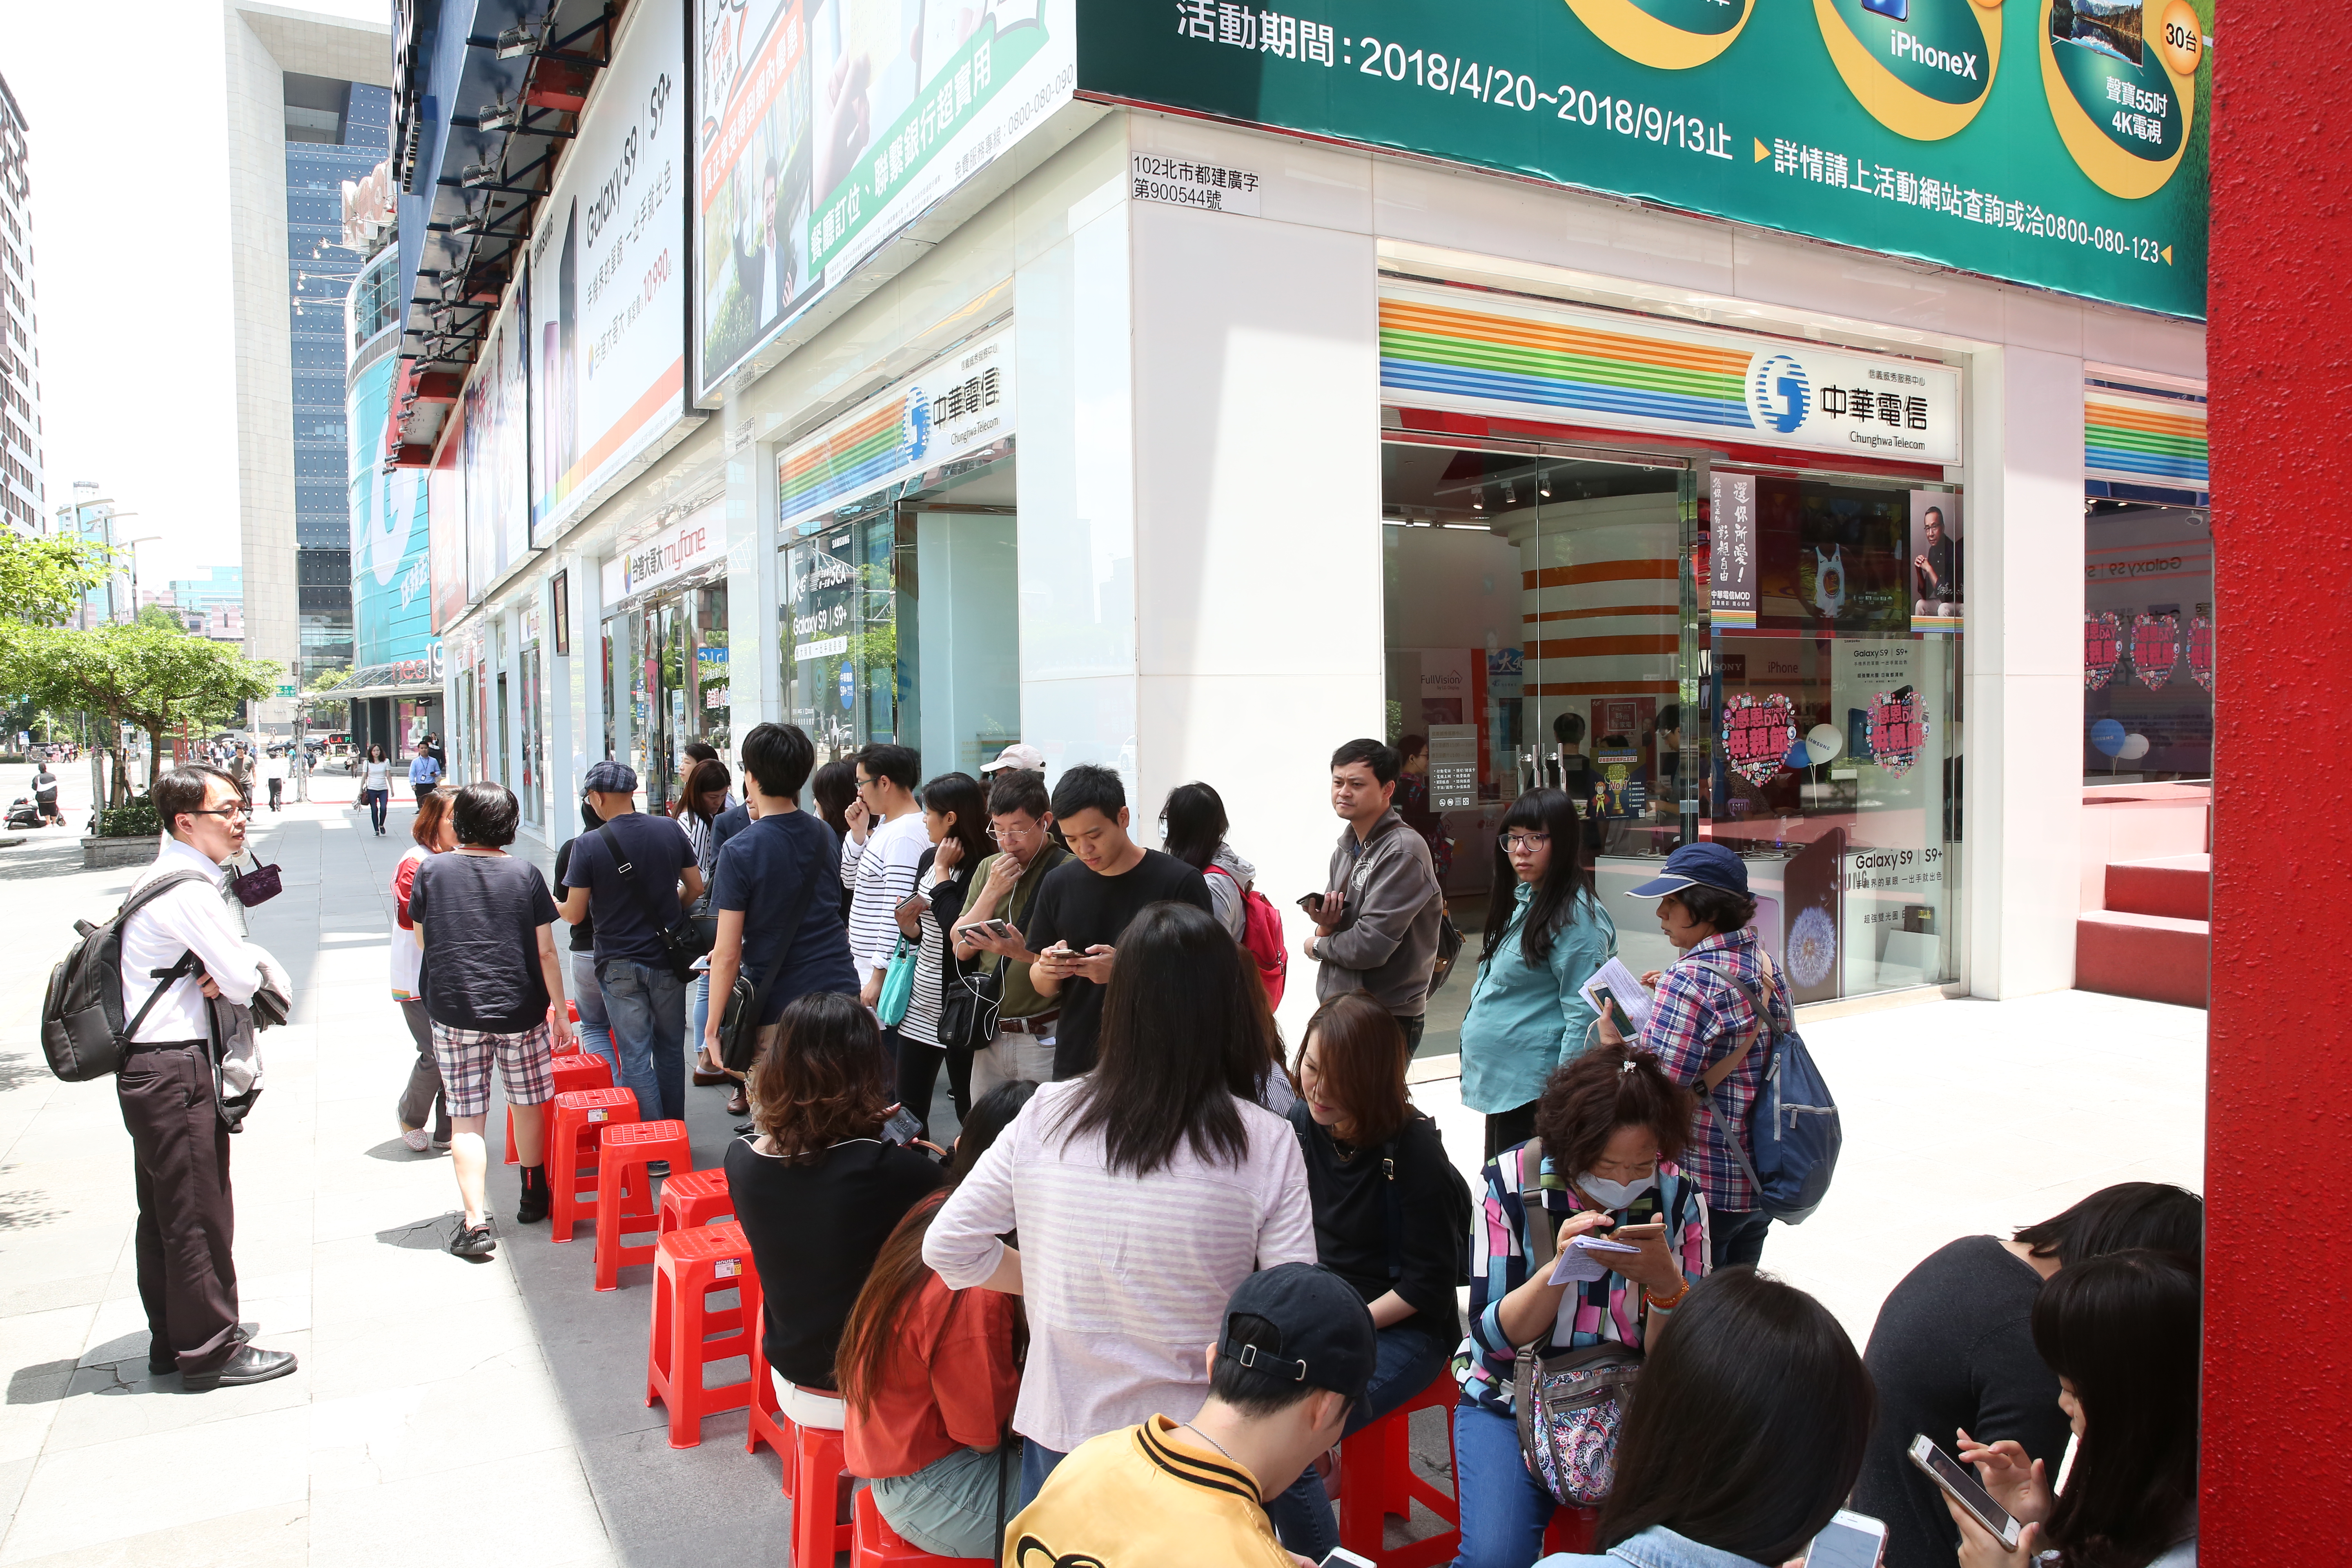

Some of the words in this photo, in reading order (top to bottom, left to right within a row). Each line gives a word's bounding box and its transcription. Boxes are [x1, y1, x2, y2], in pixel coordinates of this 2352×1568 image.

[2166, 22, 2198, 54] 30台
[1890, 30, 1977, 81] iPhoneX
[2106, 76, 2167, 117] 聲寶55吋
[2112, 114, 2163, 145] 4K電視
[587, 158, 623, 249] Galaxy
[624, 125, 637, 187] S9
[650, 73, 672, 140] S9+
[1133, 156, 1259, 193] 102北市都建廣字
[1133, 178, 1222, 211] 第900544號
[534, 213, 554, 269] SAMSUNG
[933, 367, 1000, 429] 中華電信
[1820, 384, 1928, 430] 中華電信
[951, 426, 977, 445] Chunghwa
[976, 416, 1000, 436] Telecom
[1849, 431, 1893, 448] Chunghwa
[1893, 435, 1926, 450] Telecom
[664, 527, 705, 570] myfone
[832, 535, 850, 549] SAMSUNG
[1716, 524, 1730, 581] 影視自由
[831, 564, 846, 586] 5CA
[1711, 590, 1750, 600] 中華電信MOD
[793, 615, 818, 638] Galaxy
[818, 609, 828, 630] S9
[834, 605, 847, 626] S9+
[2100, 628, 2116, 639] DAY
[1854, 650, 1879, 658] Galaxy
[1768, 662, 1798, 673] iPhone
[1421, 675, 1461, 684] FullVision
[1736, 708, 1764, 729] 感恩
[1764, 713, 1787, 726] DAY
[1878, 705, 1902, 724] 感恩
[1903, 709, 1922, 722] DAY
[1729, 726, 1788, 757] 母親節
[1808, 737, 1831, 751] SAMSUNG
[1871, 722, 1923, 751] 母親節
[1609, 780, 1628, 791] No.1
[1856, 852, 1898, 870] Galaxy
[1900, 850, 1913, 865] S9
[1925, 848, 1943, 862] S9+
[1856, 877, 1898, 890] 手機界的單眼
[1902, 872, 1942, 883] 一出手就出色
[1864, 911, 1898, 924] 超強雙光圈
